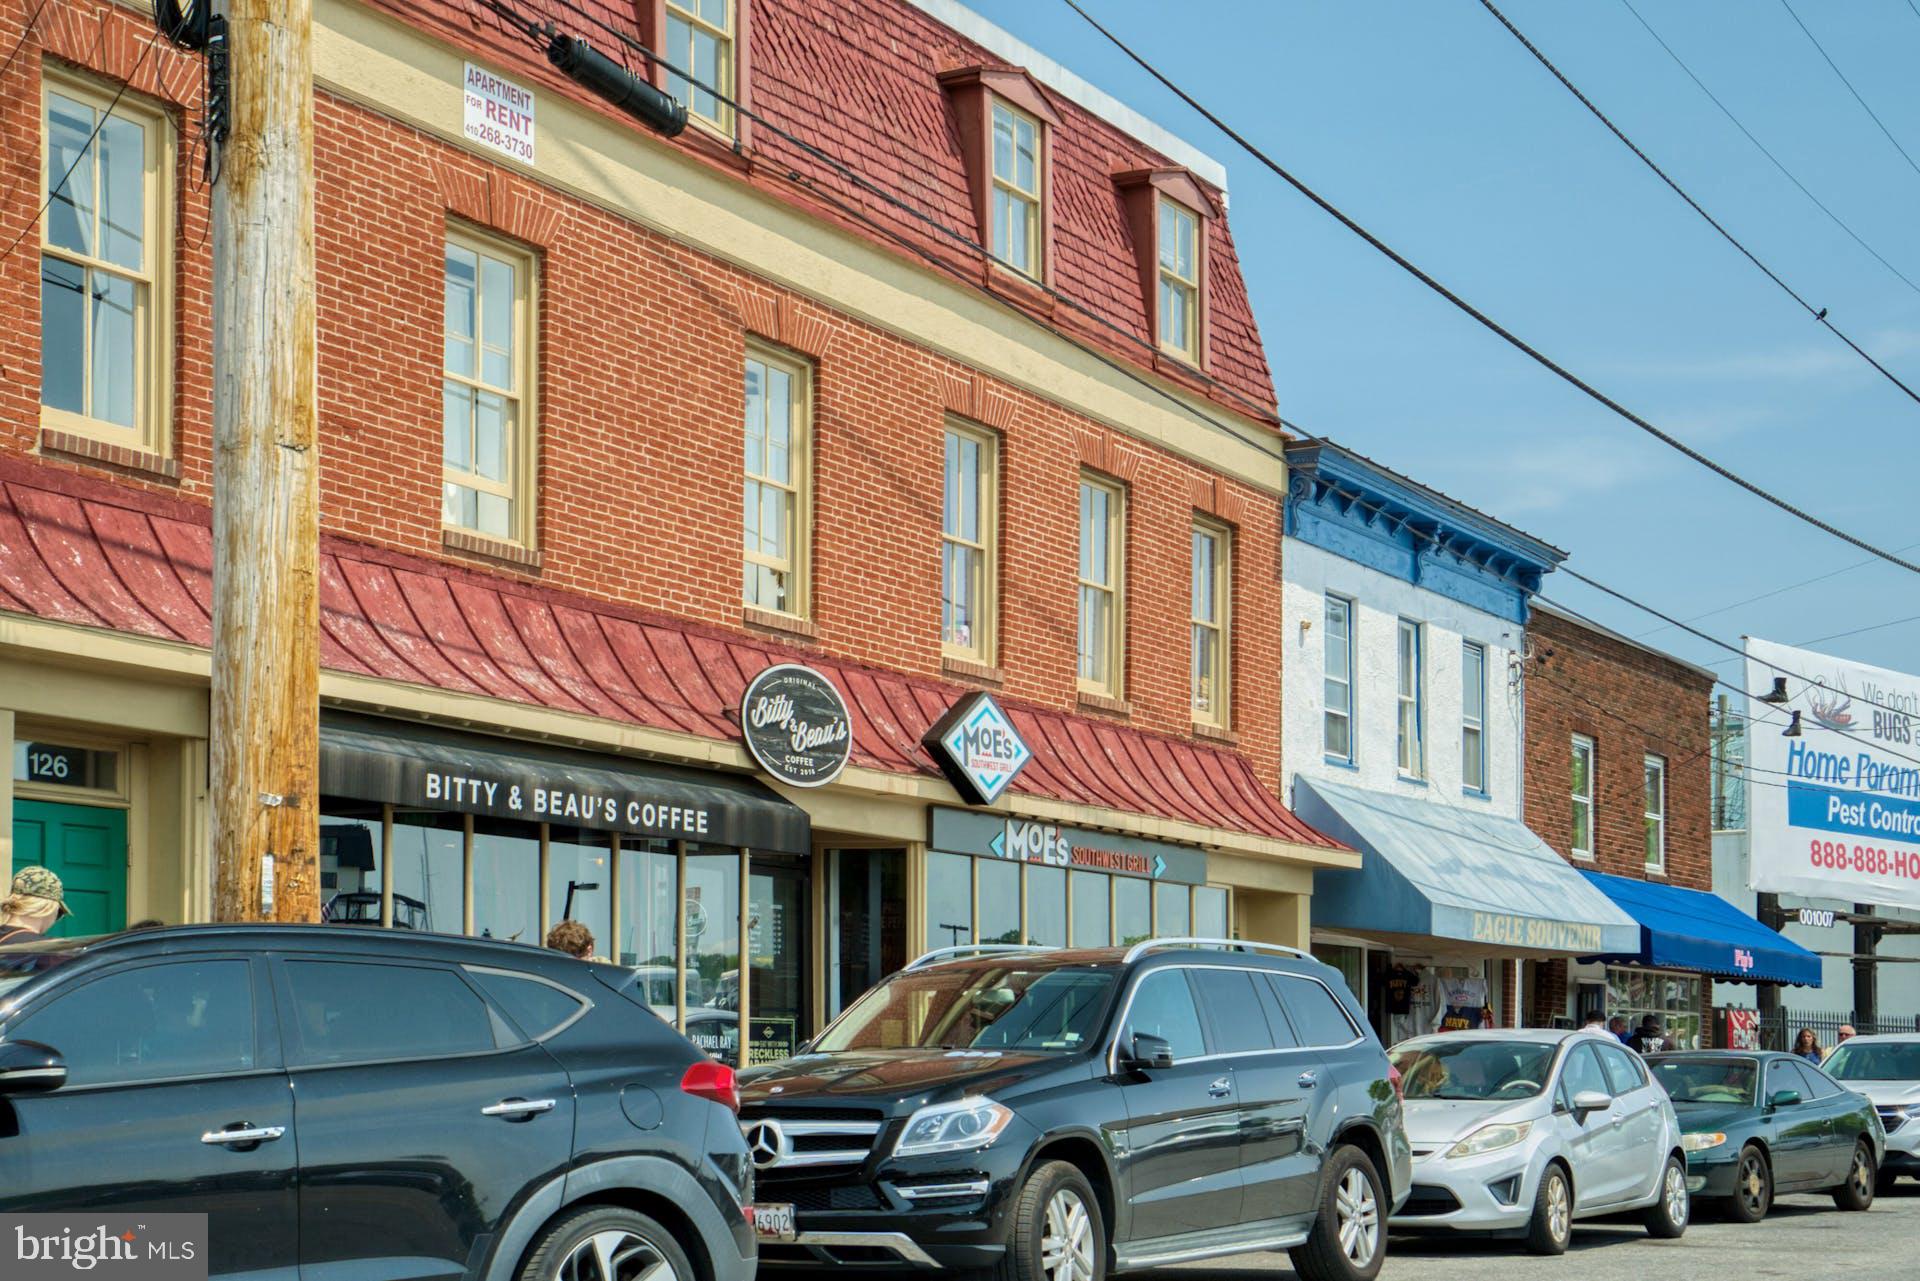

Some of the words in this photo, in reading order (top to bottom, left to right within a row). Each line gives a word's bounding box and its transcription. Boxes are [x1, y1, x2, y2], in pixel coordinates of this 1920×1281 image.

[467, 67, 531, 111] APARTMENT
[466, 95, 482, 110] FOR
[486, 98, 532, 136] RENT
[465, 123, 478, 137] 410
[480, 123, 533, 159] 268-3730
[784, 677, 817, 690] ORIGINAL
[1862, 680, 1884, 705] We
[1888, 688, 1919, 715] don't
[751, 694, 794, 730] Bitty
[790, 718, 798, 733] &
[1873, 710, 1911, 745] BUGS
[791, 716, 847, 752] Beau's
[29, 752, 68, 778] 126
[784, 765, 797, 774] EST
[785, 754, 814, 767] COFFEE
[1787, 739, 1850, 785] Home
[426, 773, 498, 807] BITTY
[508, 785, 523, 811] &
[534, 788, 617, 822] BEAU'S
[627, 801, 708, 834] COFFEE
[1828, 795, 1866, 828] Pest
[1072, 846, 1127, 871] SOUTHWEST
[1127, 854, 1150, 874] GRILL
[1810, 839, 1920, 880] 888-888-HO
[1473, 911, 1524, 944] EAGLE
[1527, 919, 1602, 950] SOUVENIR
[1800, 908, 1834, 928] 001007
[1445, 1016, 1470, 1029] NAVY
[692, 1035, 719, 1049] RACHAEL
[720, 1035, 732, 1049] RAY
[748, 1048, 790, 1060] RECKLESS
